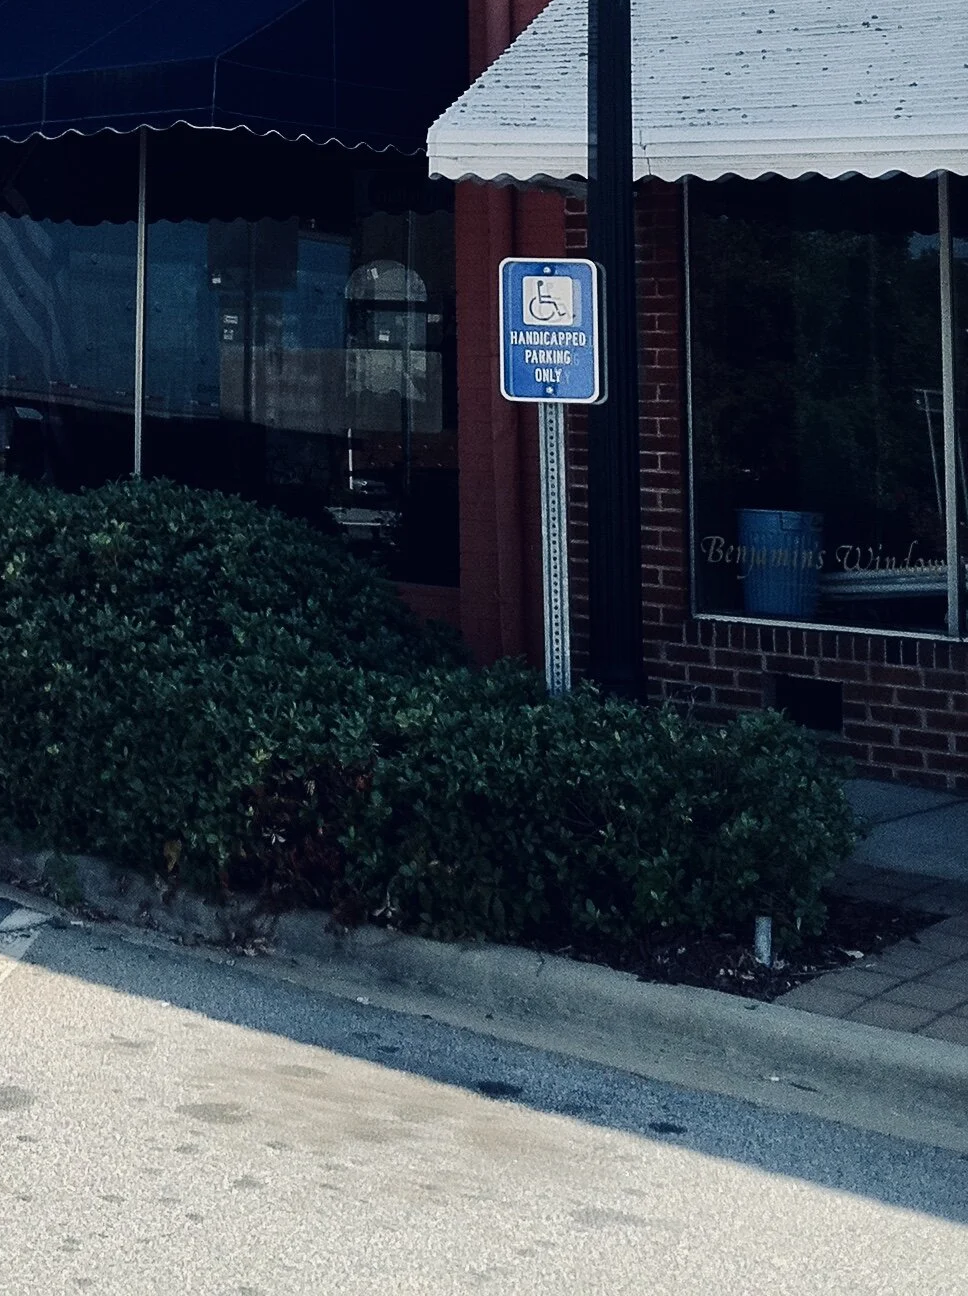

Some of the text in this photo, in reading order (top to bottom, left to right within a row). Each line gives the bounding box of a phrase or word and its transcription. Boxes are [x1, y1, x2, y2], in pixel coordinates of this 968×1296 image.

[510, 331, 586, 346] HANDICAPPED
[525, 349, 572, 364] PARKING
[535, 368, 564, 383] ONLY
